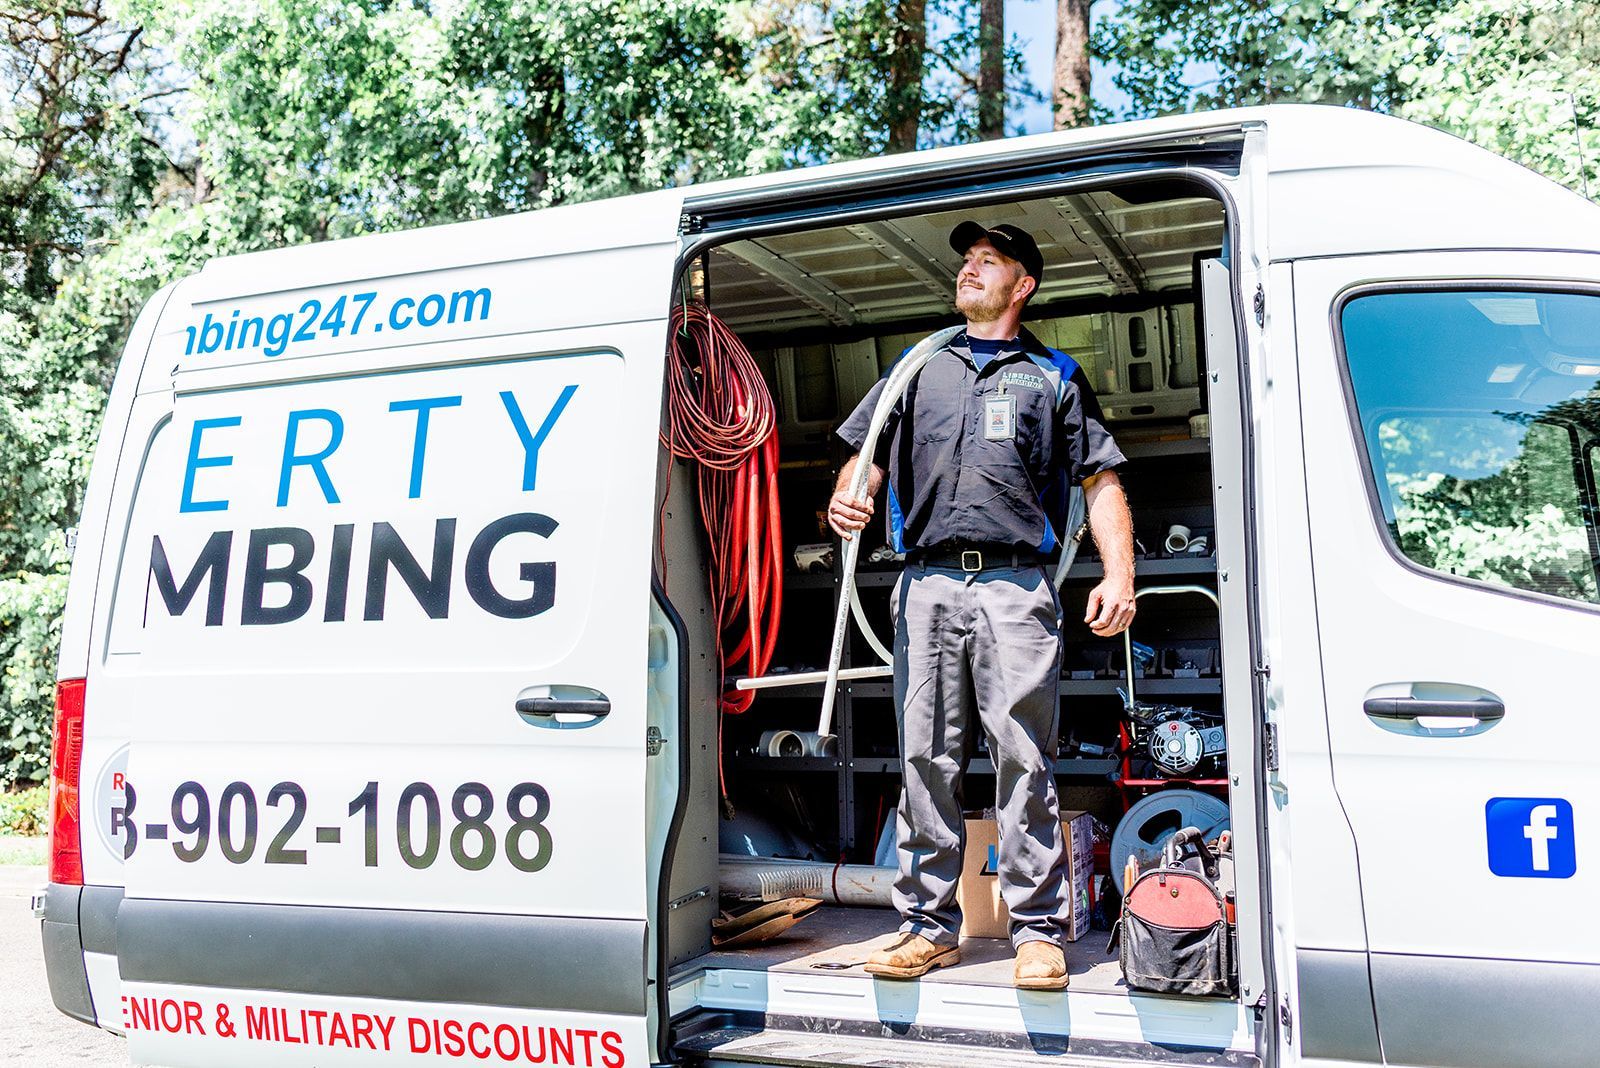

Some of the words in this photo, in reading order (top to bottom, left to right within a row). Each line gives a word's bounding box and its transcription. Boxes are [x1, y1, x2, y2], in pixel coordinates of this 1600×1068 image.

[179, 384, 579, 514] ERTY
[143, 512, 560, 629] MBING
[215, 1003, 237, 1038] &
[245, 1005, 396, 1051] MILITARY
[407, 1017, 625, 1068] DISCOUNTS
